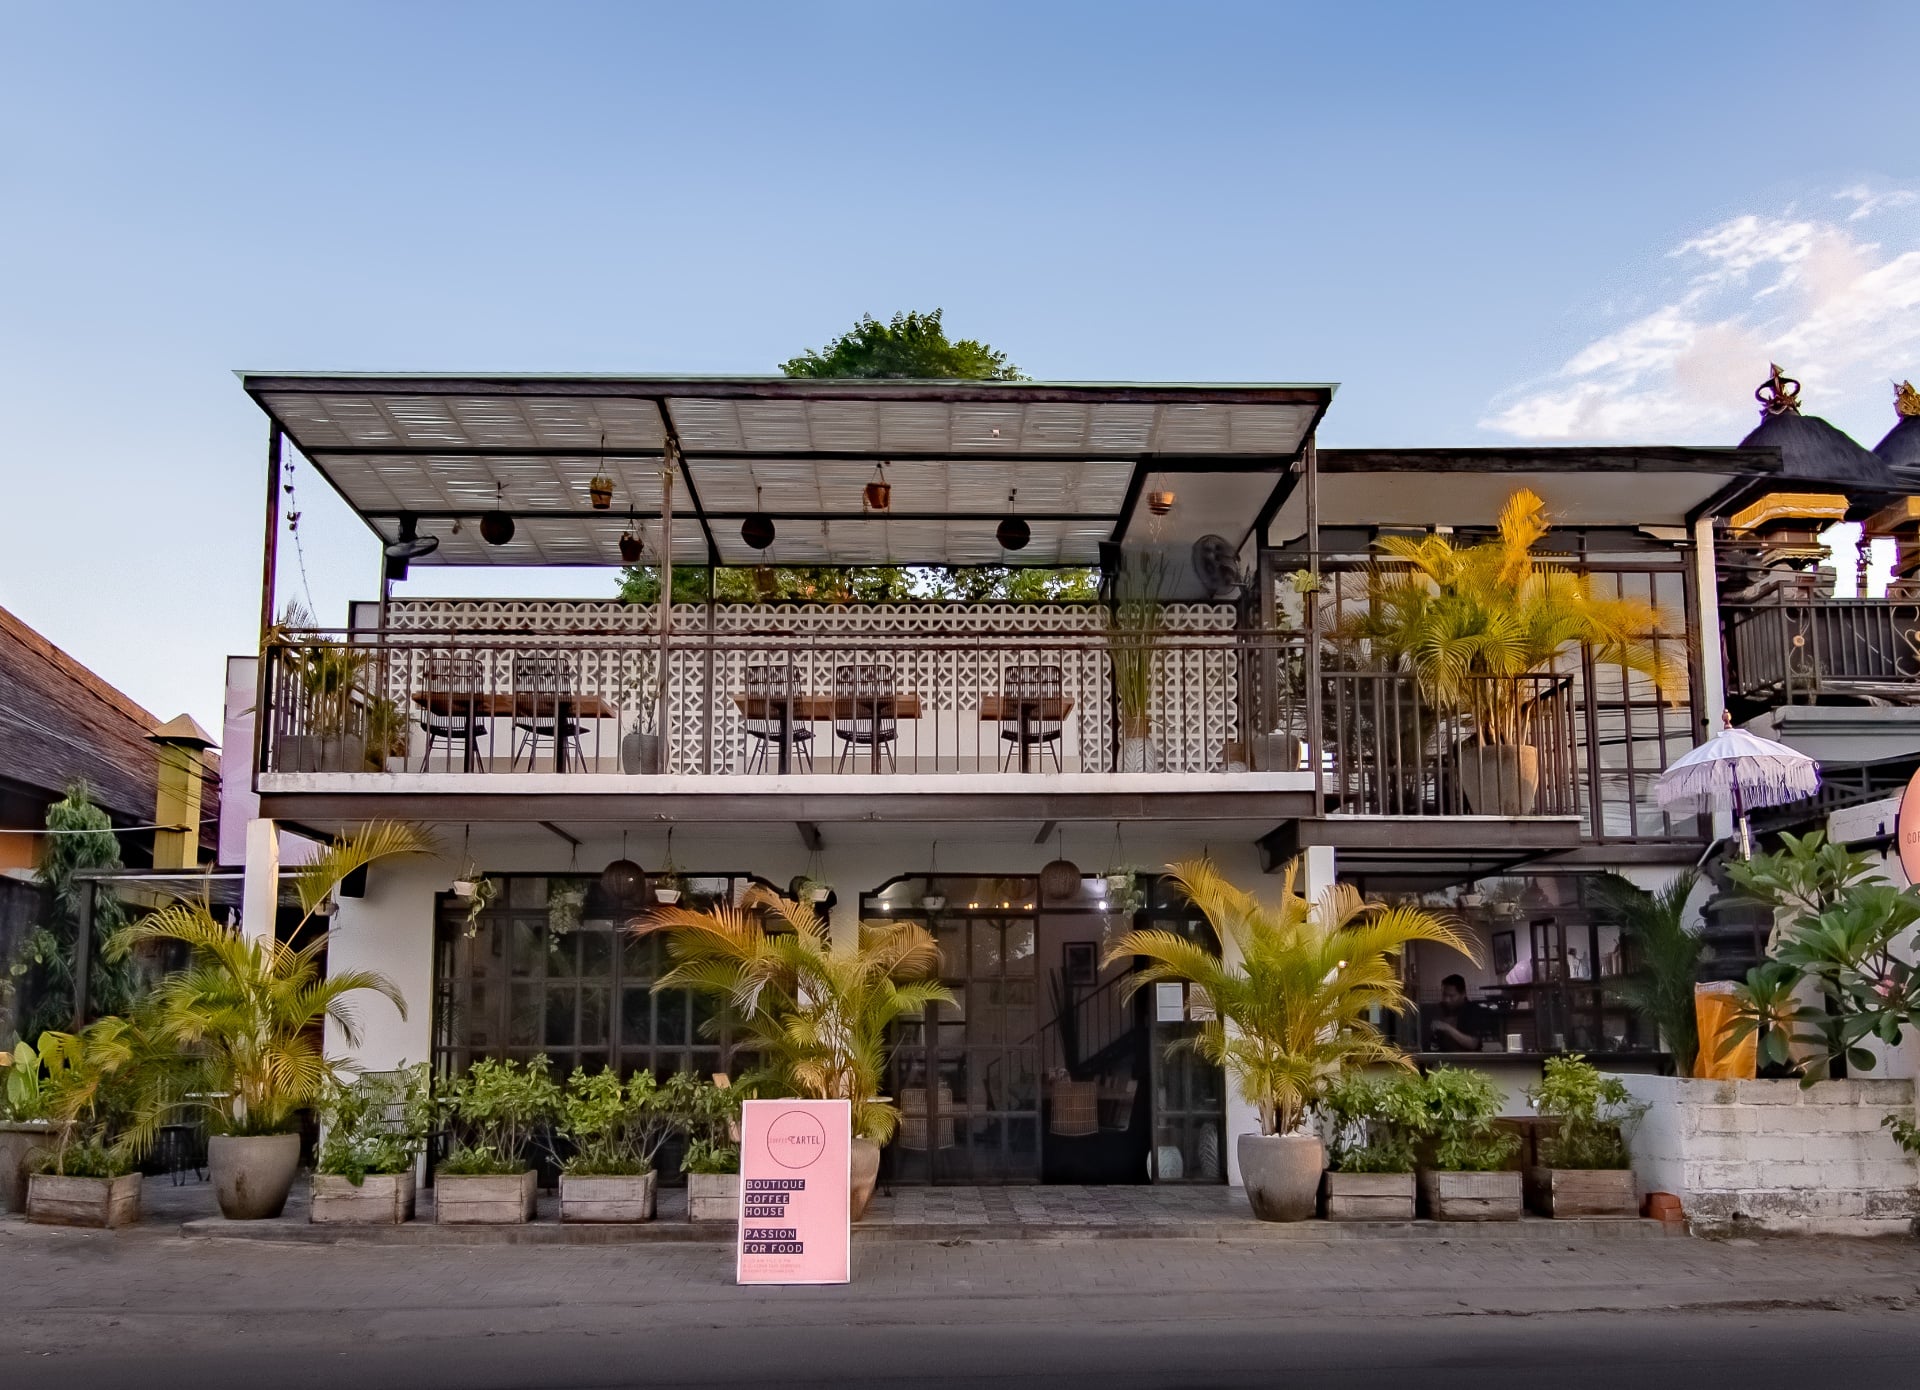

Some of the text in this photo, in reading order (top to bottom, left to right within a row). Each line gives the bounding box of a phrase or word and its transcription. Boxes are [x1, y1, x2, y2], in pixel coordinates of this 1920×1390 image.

[788, 1135, 820, 1145] CARTEL
[746, 1180, 804, 1189] BOUTIQUE
[745, 1194, 789, 1204] COFFEE
[745, 1207, 784, 1217] HOUSE
[745, 1229, 795, 1239] PASSION
[744, 1244, 803, 1253] FOR FOOD
